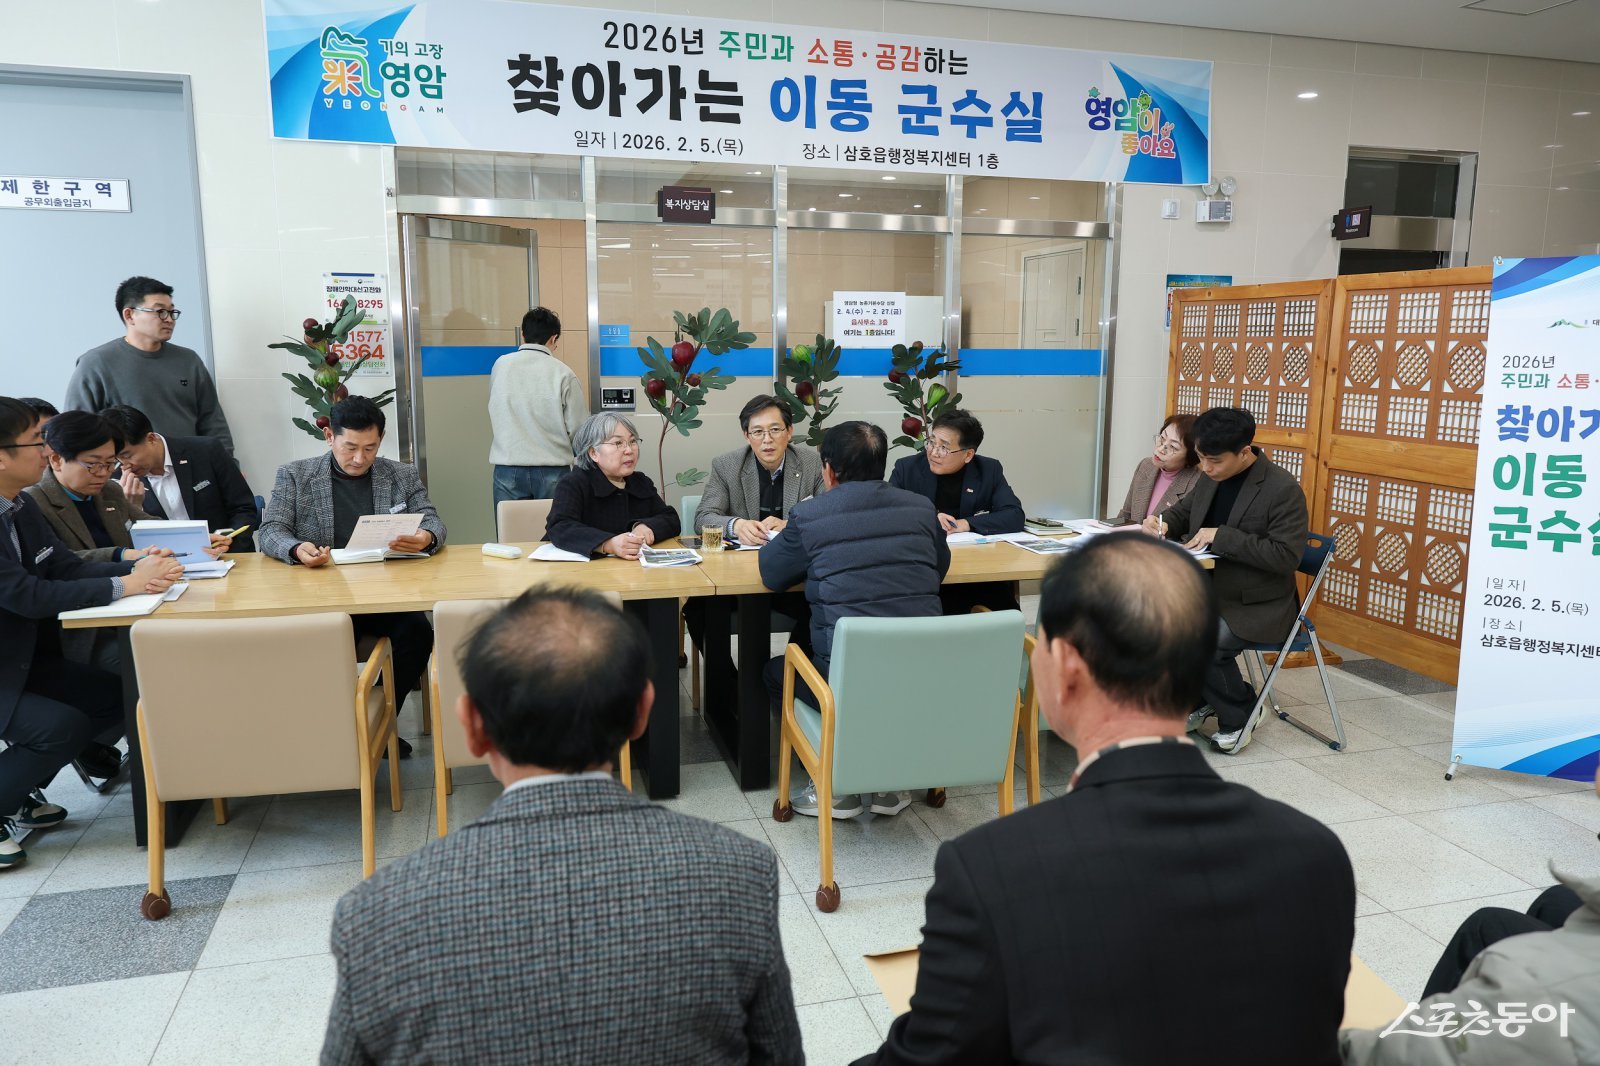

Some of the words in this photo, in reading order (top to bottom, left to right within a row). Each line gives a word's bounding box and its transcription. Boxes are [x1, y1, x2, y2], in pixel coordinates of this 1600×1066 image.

[380, 40, 408, 57] 기의
[414, 43, 443, 60] 고장
[603, 21, 704, 55] 2026년
[718, 30, 794, 63] 주민과
[380, 61, 447, 100] 영암
[324, 98, 444, 114] YEONGAM
[507, 53, 744, 125] 찾아가는
[770, 74, 873, 133] 이동
[897, 83, 1044, 144] 군수실
[1085, 97, 1160, 134] 영암이
[574, 130, 606, 148] 일자
[622, 133, 670, 151] 2026.
[677, 136, 693, 152] 2.
[700, 137, 744, 156] 5.(목)
[1121, 132, 1176, 158] 좋아요
[802, 143, 831, 160] 장소
[843, 144, 971, 168] 삼호읍행정복지센터
[977, 153, 1000, 170] 1층
[24, 196, 92, 208] 공무외출입금지
[665, 198, 710, 211] 복지상담실
[327, 298, 384, 309] 1648295
[333, 343, 385, 360] 5364
[1502, 355, 1555, 369] 2026년
[1501, 373, 1550, 389] 주민과
[1492, 453, 1587, 499] 이동
[1483, 594, 1526, 610] 2026.
[1531, 598, 1545, 612] 2.
[1551, 600, 1589, 617] 5.(목)
